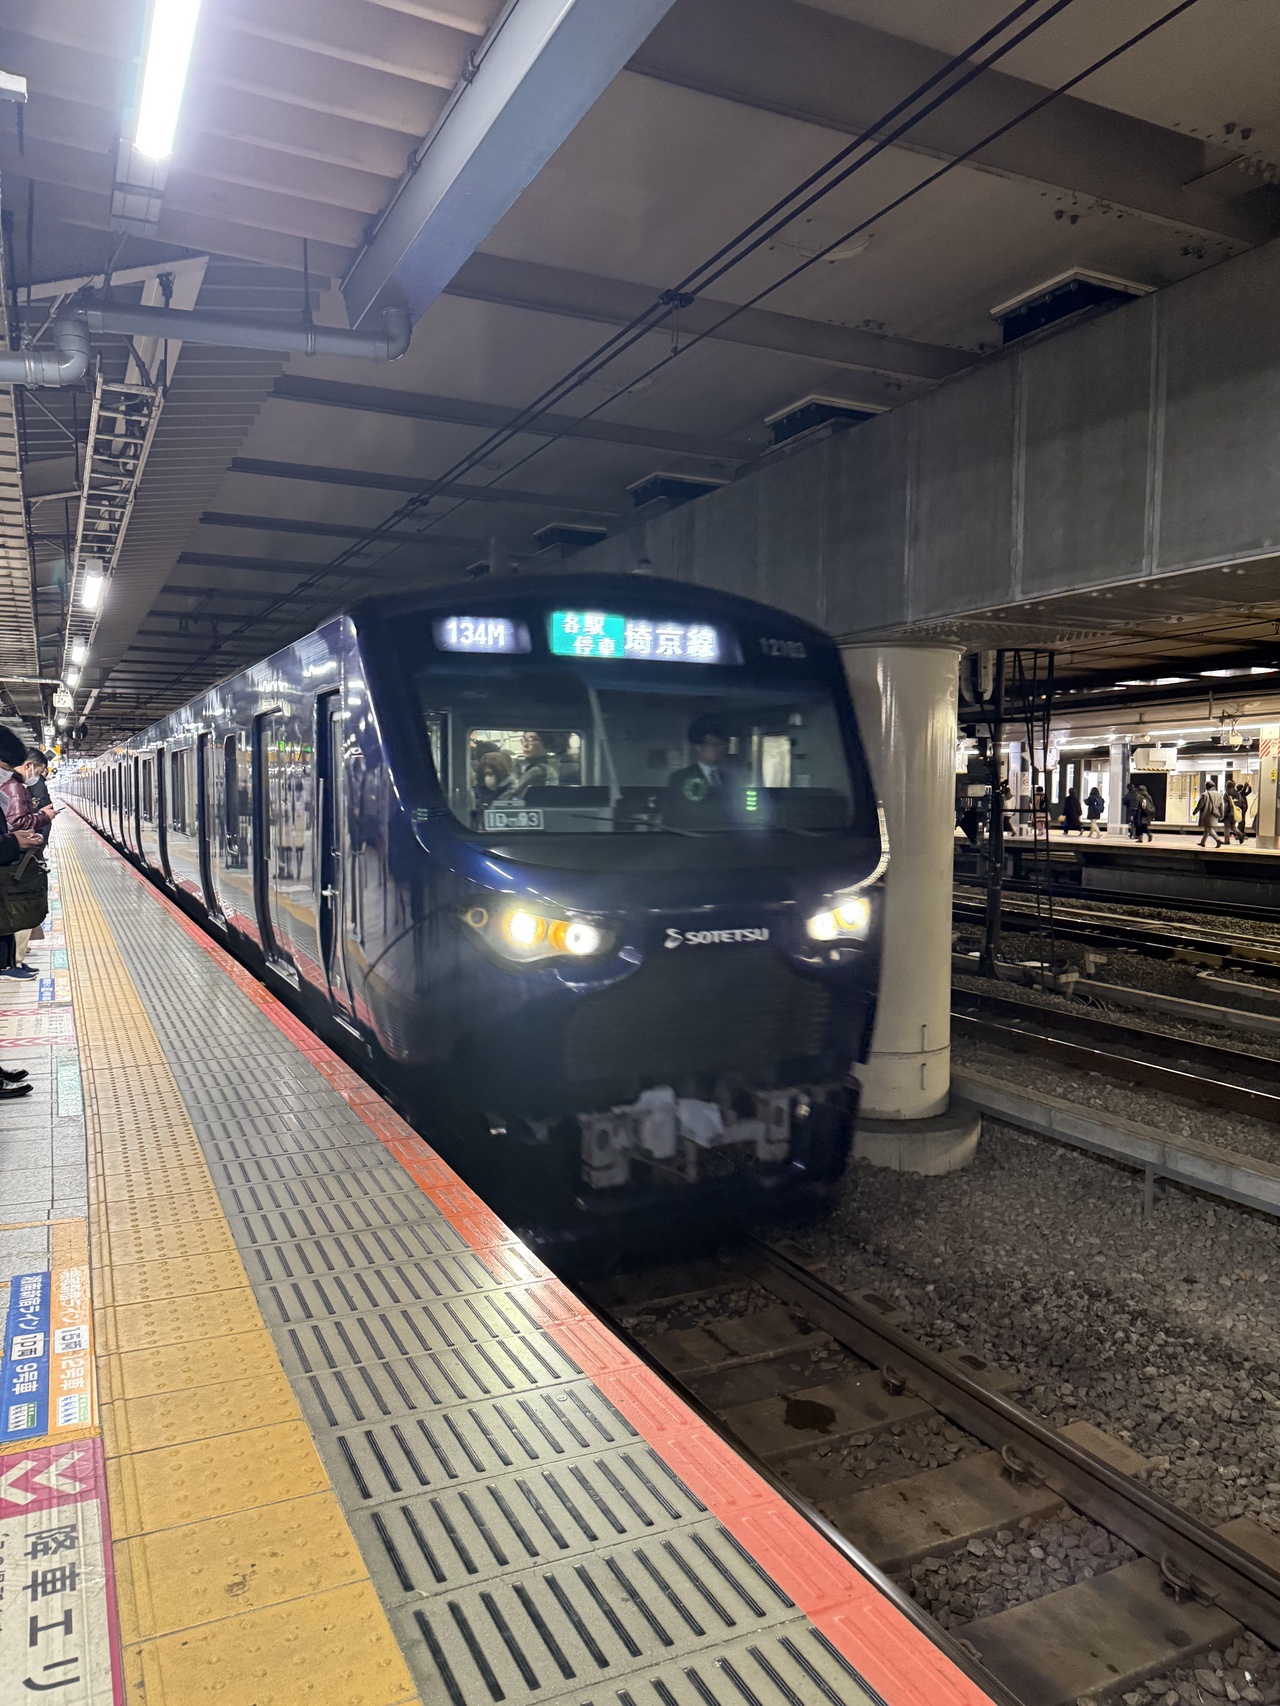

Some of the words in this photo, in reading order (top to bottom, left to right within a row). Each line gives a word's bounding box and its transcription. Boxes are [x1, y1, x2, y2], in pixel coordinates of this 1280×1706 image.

[447, 621, 505, 646] 134M
[562, 613, 605, 636] 各駅
[573, 635, 617, 656] 停車
[624, 623, 716, 658] 埼京線
[684, 927, 770, 945] SOTETSU
[19, 1274, 43, 1330] 湘南新宿ライン
[12, 1362, 39, 1396] 9号車
[60, 1351, 86, 1391] 12号車
